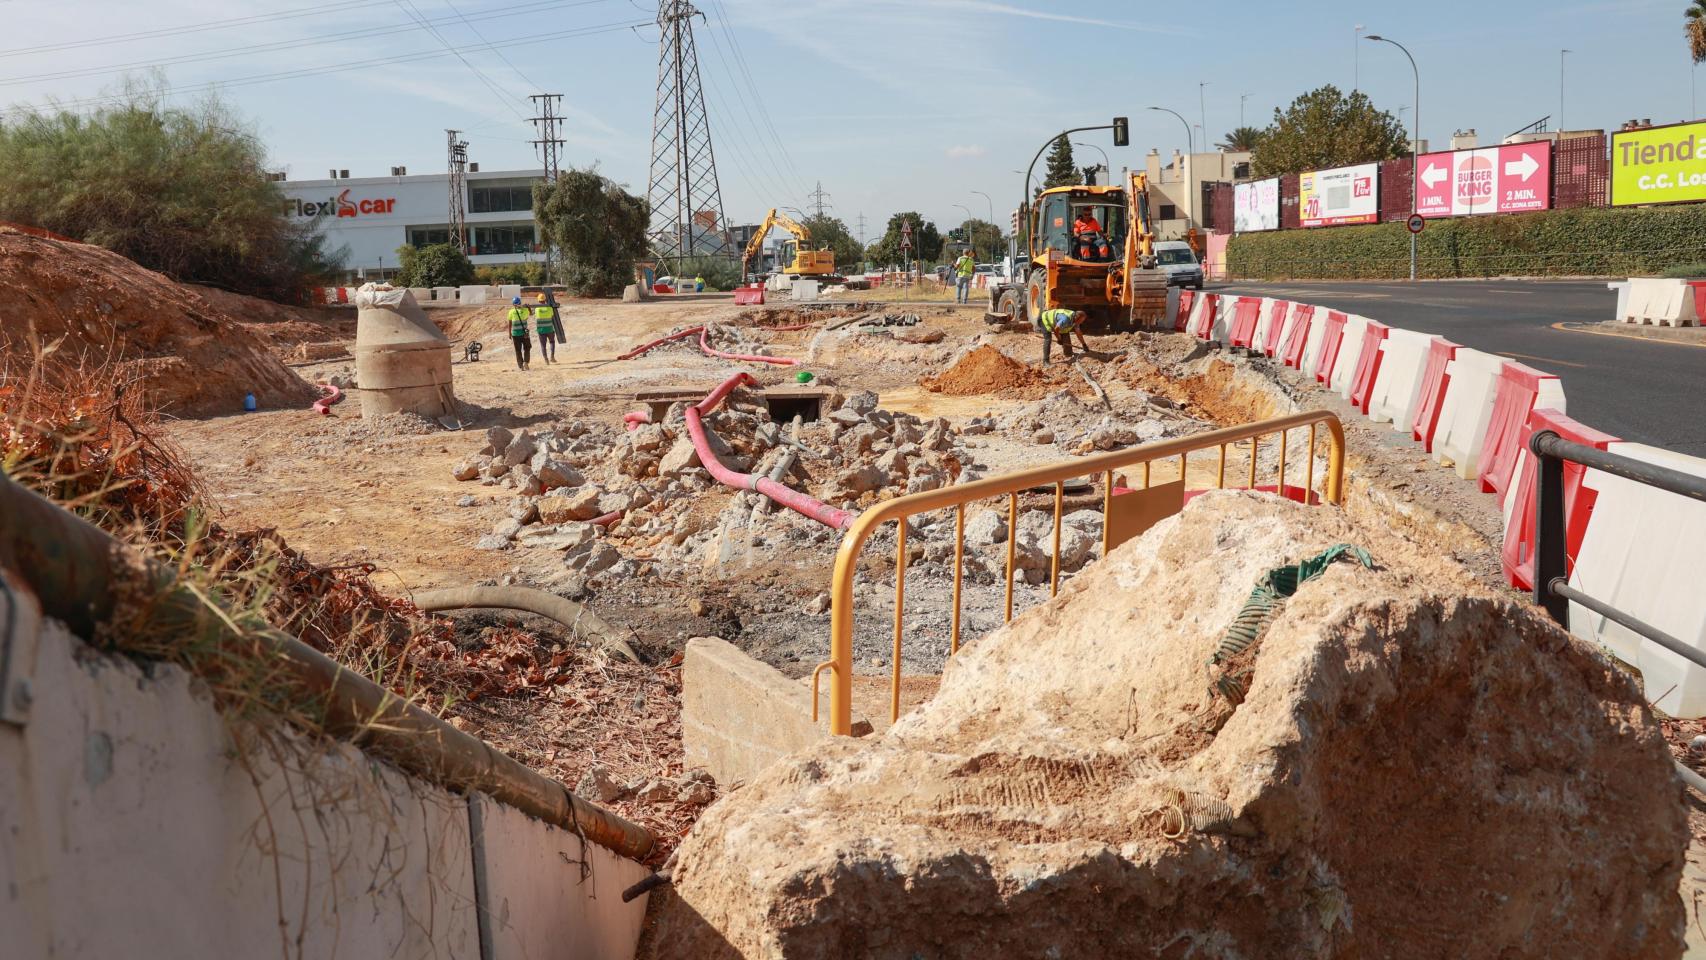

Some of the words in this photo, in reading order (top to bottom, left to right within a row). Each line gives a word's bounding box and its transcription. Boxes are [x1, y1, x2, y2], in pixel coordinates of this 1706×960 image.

[1458, 170, 1492, 182] BURGER
[1638, 173, 1674, 191] C.C.
[1458, 181, 1492, 197] KING
[1506, 190, 1513, 201] 2
[1514, 188, 1536, 200] MIN.
[1426, 196, 1444, 207] MIN.
